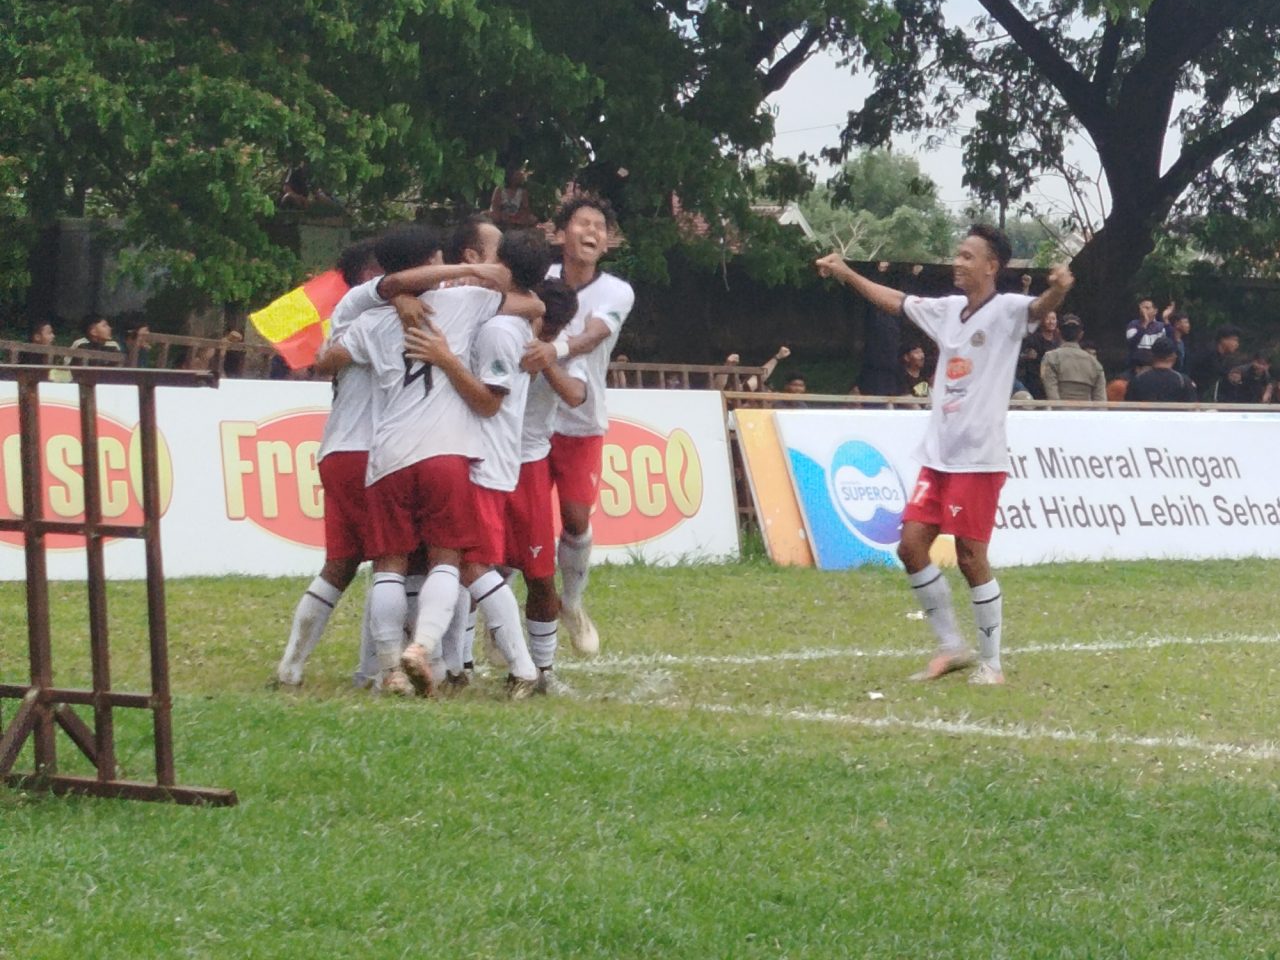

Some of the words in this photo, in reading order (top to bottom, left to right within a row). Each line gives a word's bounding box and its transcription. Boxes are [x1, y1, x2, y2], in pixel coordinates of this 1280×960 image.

[1007, 447, 1028, 479] ir
[1035, 447, 1141, 479] Mineral
[1149, 447, 1241, 487] Ringan
[1038, 496, 1126, 535] Hidup
[1132, 494, 1210, 528] Lebih
